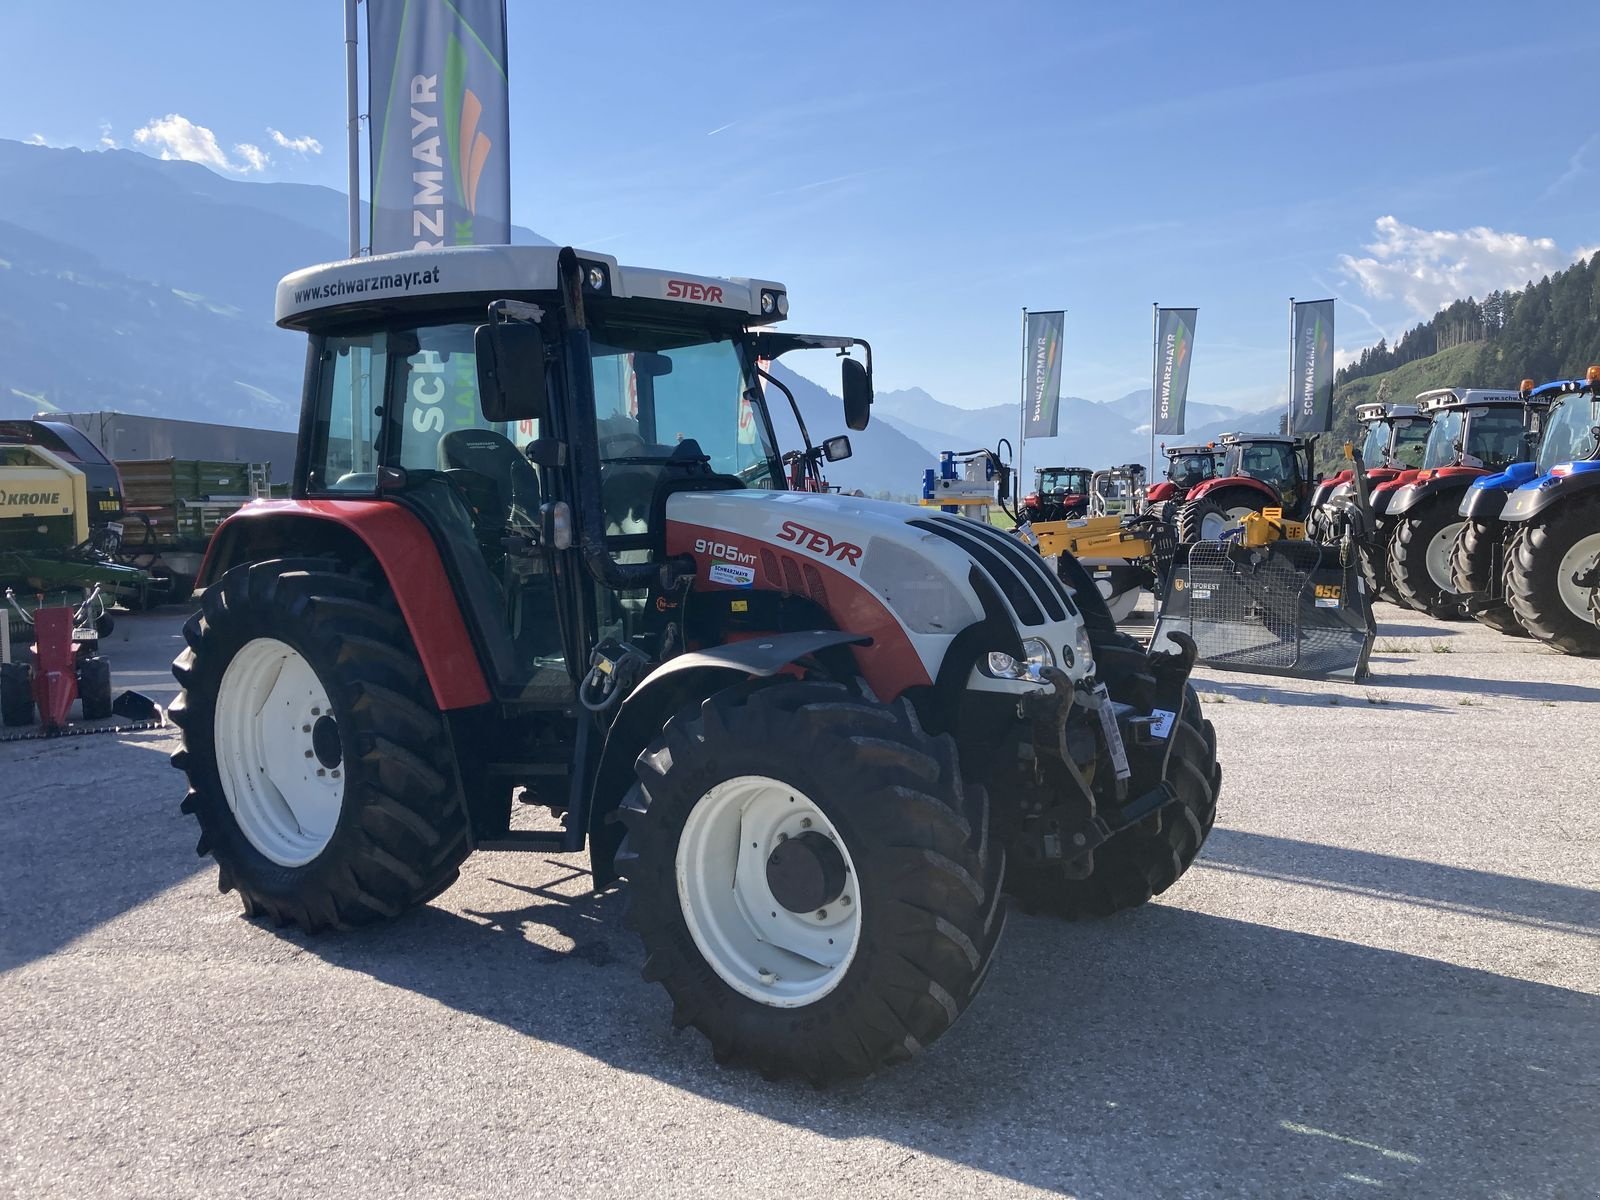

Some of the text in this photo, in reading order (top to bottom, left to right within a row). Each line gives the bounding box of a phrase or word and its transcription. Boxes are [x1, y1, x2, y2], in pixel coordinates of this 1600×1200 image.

[294, 265, 440, 304] www.schwarzmayr.at
[666, 279, 724, 304] STEYR
[1032, 337, 1047, 421] SCHWARZMAYR
[1161, 334, 1176, 419] SCHWARZMAYR
[1304, 327, 1315, 415] SCHWARZMAYR
[7, 493, 60, 505] KRONE
[694, 538, 758, 565] 9105MT
[776, 520, 863, 567] STEYR
[714, 565, 748, 577] SCHWARZMAYR
